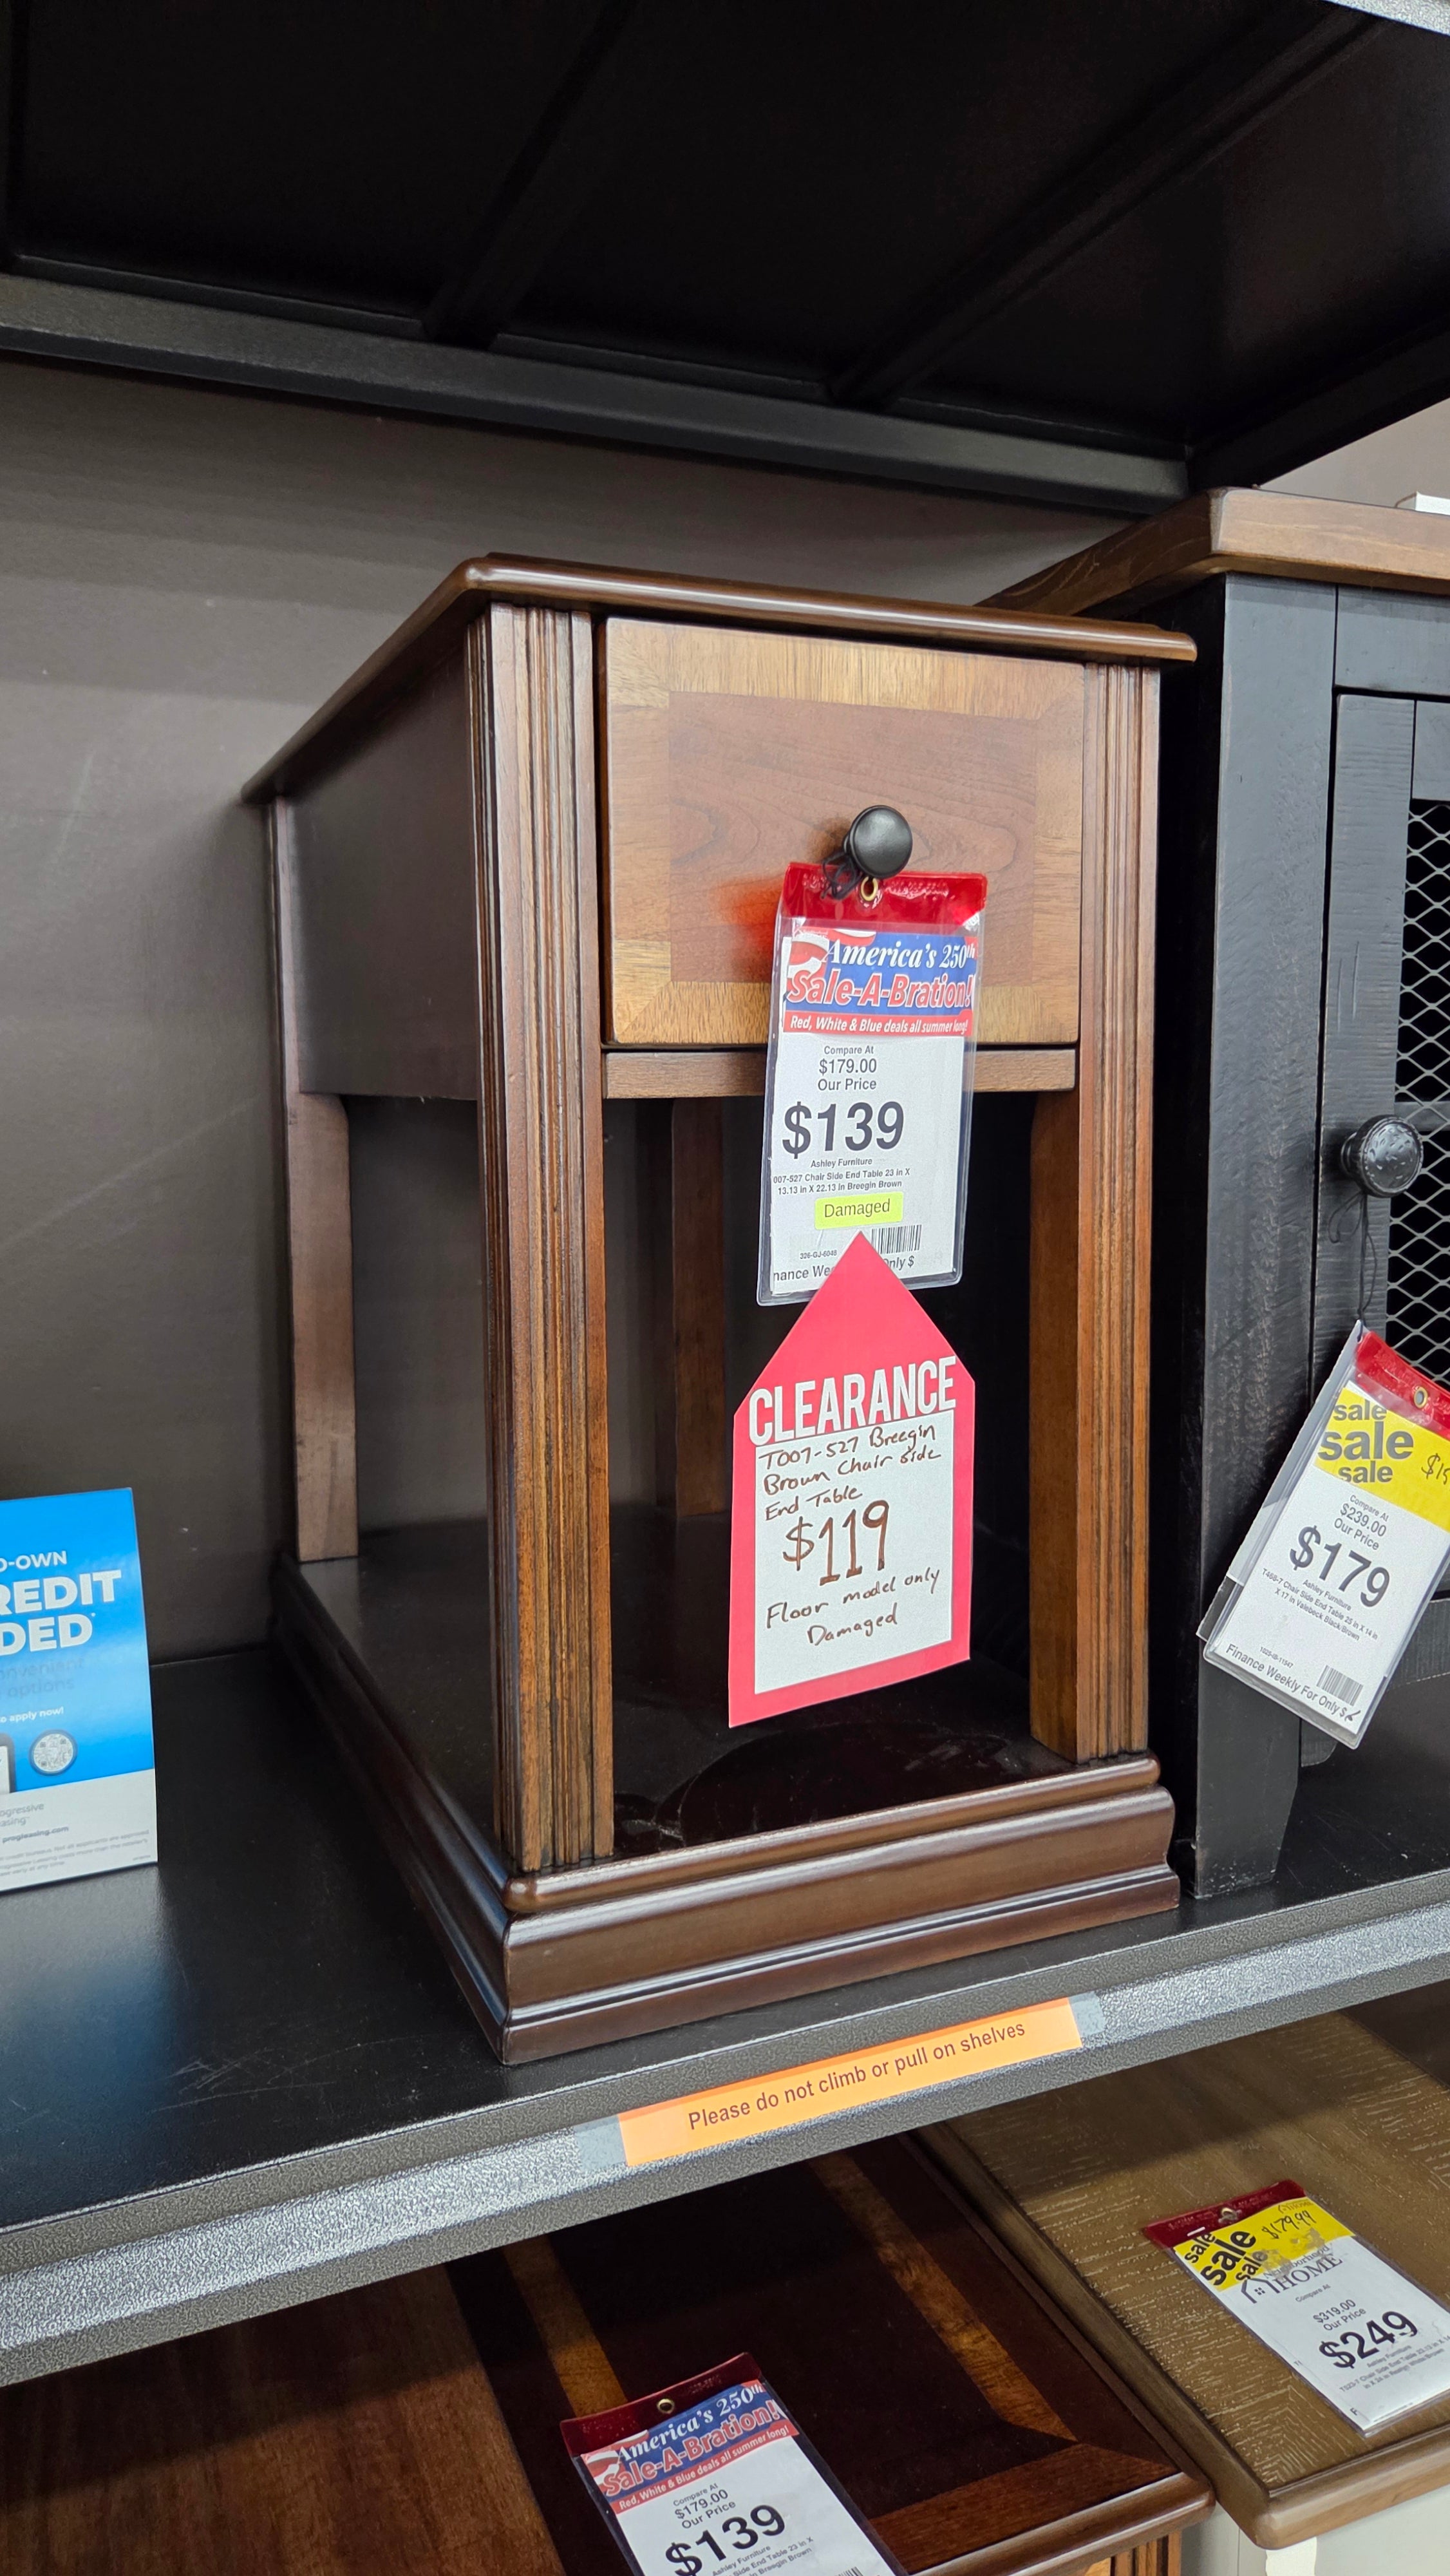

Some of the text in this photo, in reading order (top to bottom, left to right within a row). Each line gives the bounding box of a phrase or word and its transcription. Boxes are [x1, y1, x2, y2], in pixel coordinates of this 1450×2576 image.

[822, 939, 975, 969] America's 250th
[786, 969, 974, 1008] Sale-A-Bration!
[791, 1016, 968, 1034] Red, White & Blue deals all summer long!
[819, 1058, 877, 1074] $179.00
[824, 1046, 874, 1057] Compare At
[818, 1077, 876, 1091] Our Price
[782, 1101, 904, 1159] $139
[805, 1173, 824, 1182] Chair
[827, 1172, 843, 1180] Side
[845, 1171, 860, 1179] End
[863, 1170, 883, 1178] Table
[811, 1158, 872, 1168] Ashley Furniture
[778, 1186, 798, 1195] 13.13
[816, 1184, 836, 1193] 22.13
[847, 1182, 876, 1190] Breegin
[824, 1198, 890, 1217] Damaged
[908, 1255, 914, 1267] $
[749, 1356, 956, 1446] CLEARANCE
[1333, 1399, 1387, 1421] sale
[758, 1436, 859, 1470] T007-527
[1318, 1421, 1413, 1461] sale
[764, 1471, 830, 1495] Brown
[838, 1454, 892, 1475] Chair
[1338, 1461, 1393, 1483] sale
[766, 1486, 863, 1521] End Table
[1350, 1495, 1389, 1522] Compare At
[1335, 1518, 1379, 1550] Our Price
[1341, 1503, 1386, 1537] $239.00
[782, 1500, 889, 1586] $119
[1290, 1525, 1389, 1607] $179
[767, 1567, 940, 1629] Floor model only
[1281, 1591, 1288, 1599] 17
[1289, 1595, 1295, 1604] in
[1283, 1581, 1299, 1595] Chair
[1300, 1591, 1313, 1603] Side
[1314, 1598, 1327, 1610] End
[1328, 1605, 1344, 1620] Table
[1344, 1616, 1353, 1625] 25
[1353, 1621, 1359, 1629] in
[1372, 1632, 1378, 1640] in
[1303, 1580, 1351, 1611] Ashley Furniture
[807, 1602, 898, 1645] Damaged
[1226, 1643, 1265, 1672] Finance
[1266, 1665, 1301, 1693] Weekly
[1301, 1685, 1318, 1701] For
[1319, 1696, 1340, 1715] Only
[10, 1711, 37, 1723] apply
[39, 1707, 64, 1717] now!
[688, 2022, 1026, 2130] Please do not climb or pull on shelves
[1261, 2210, 1317, 2239] $179.99
[1185, 2233, 1216, 2264] sale
[1200, 2230, 1256, 2286] sale
[1235, 2251, 1268, 2282] sale
[1274, 2253, 1343, 2291] HOME
[1295, 2289, 1321, 2302] Compare
[1313, 2299, 1356, 2324] $319.00
[1323, 2308, 1366, 2331] Our Price
[1319, 2311, 1418, 2369] $249
[617, 2383, 764, 2464] America's 250th
[603, 2400, 780, 2496] Sale-A-Bration!
[619, 2425, 789, 2511] Red, White & Blue deals all summer long!
[673, 2483, 718, 2506] Compare At
[675, 2489, 729, 2519] $179.00
[681, 2501, 736, 2530] Our Price
[665, 2505, 786, 2576] $139
[787, 2547, 812, 2562] Brown
[712, 2545, 771, 2576] Ashley Furniture
[751, 2558, 766, 2570] End
[767, 2550, 788, 2562] Table
[788, 2543, 798, 2552] 23
